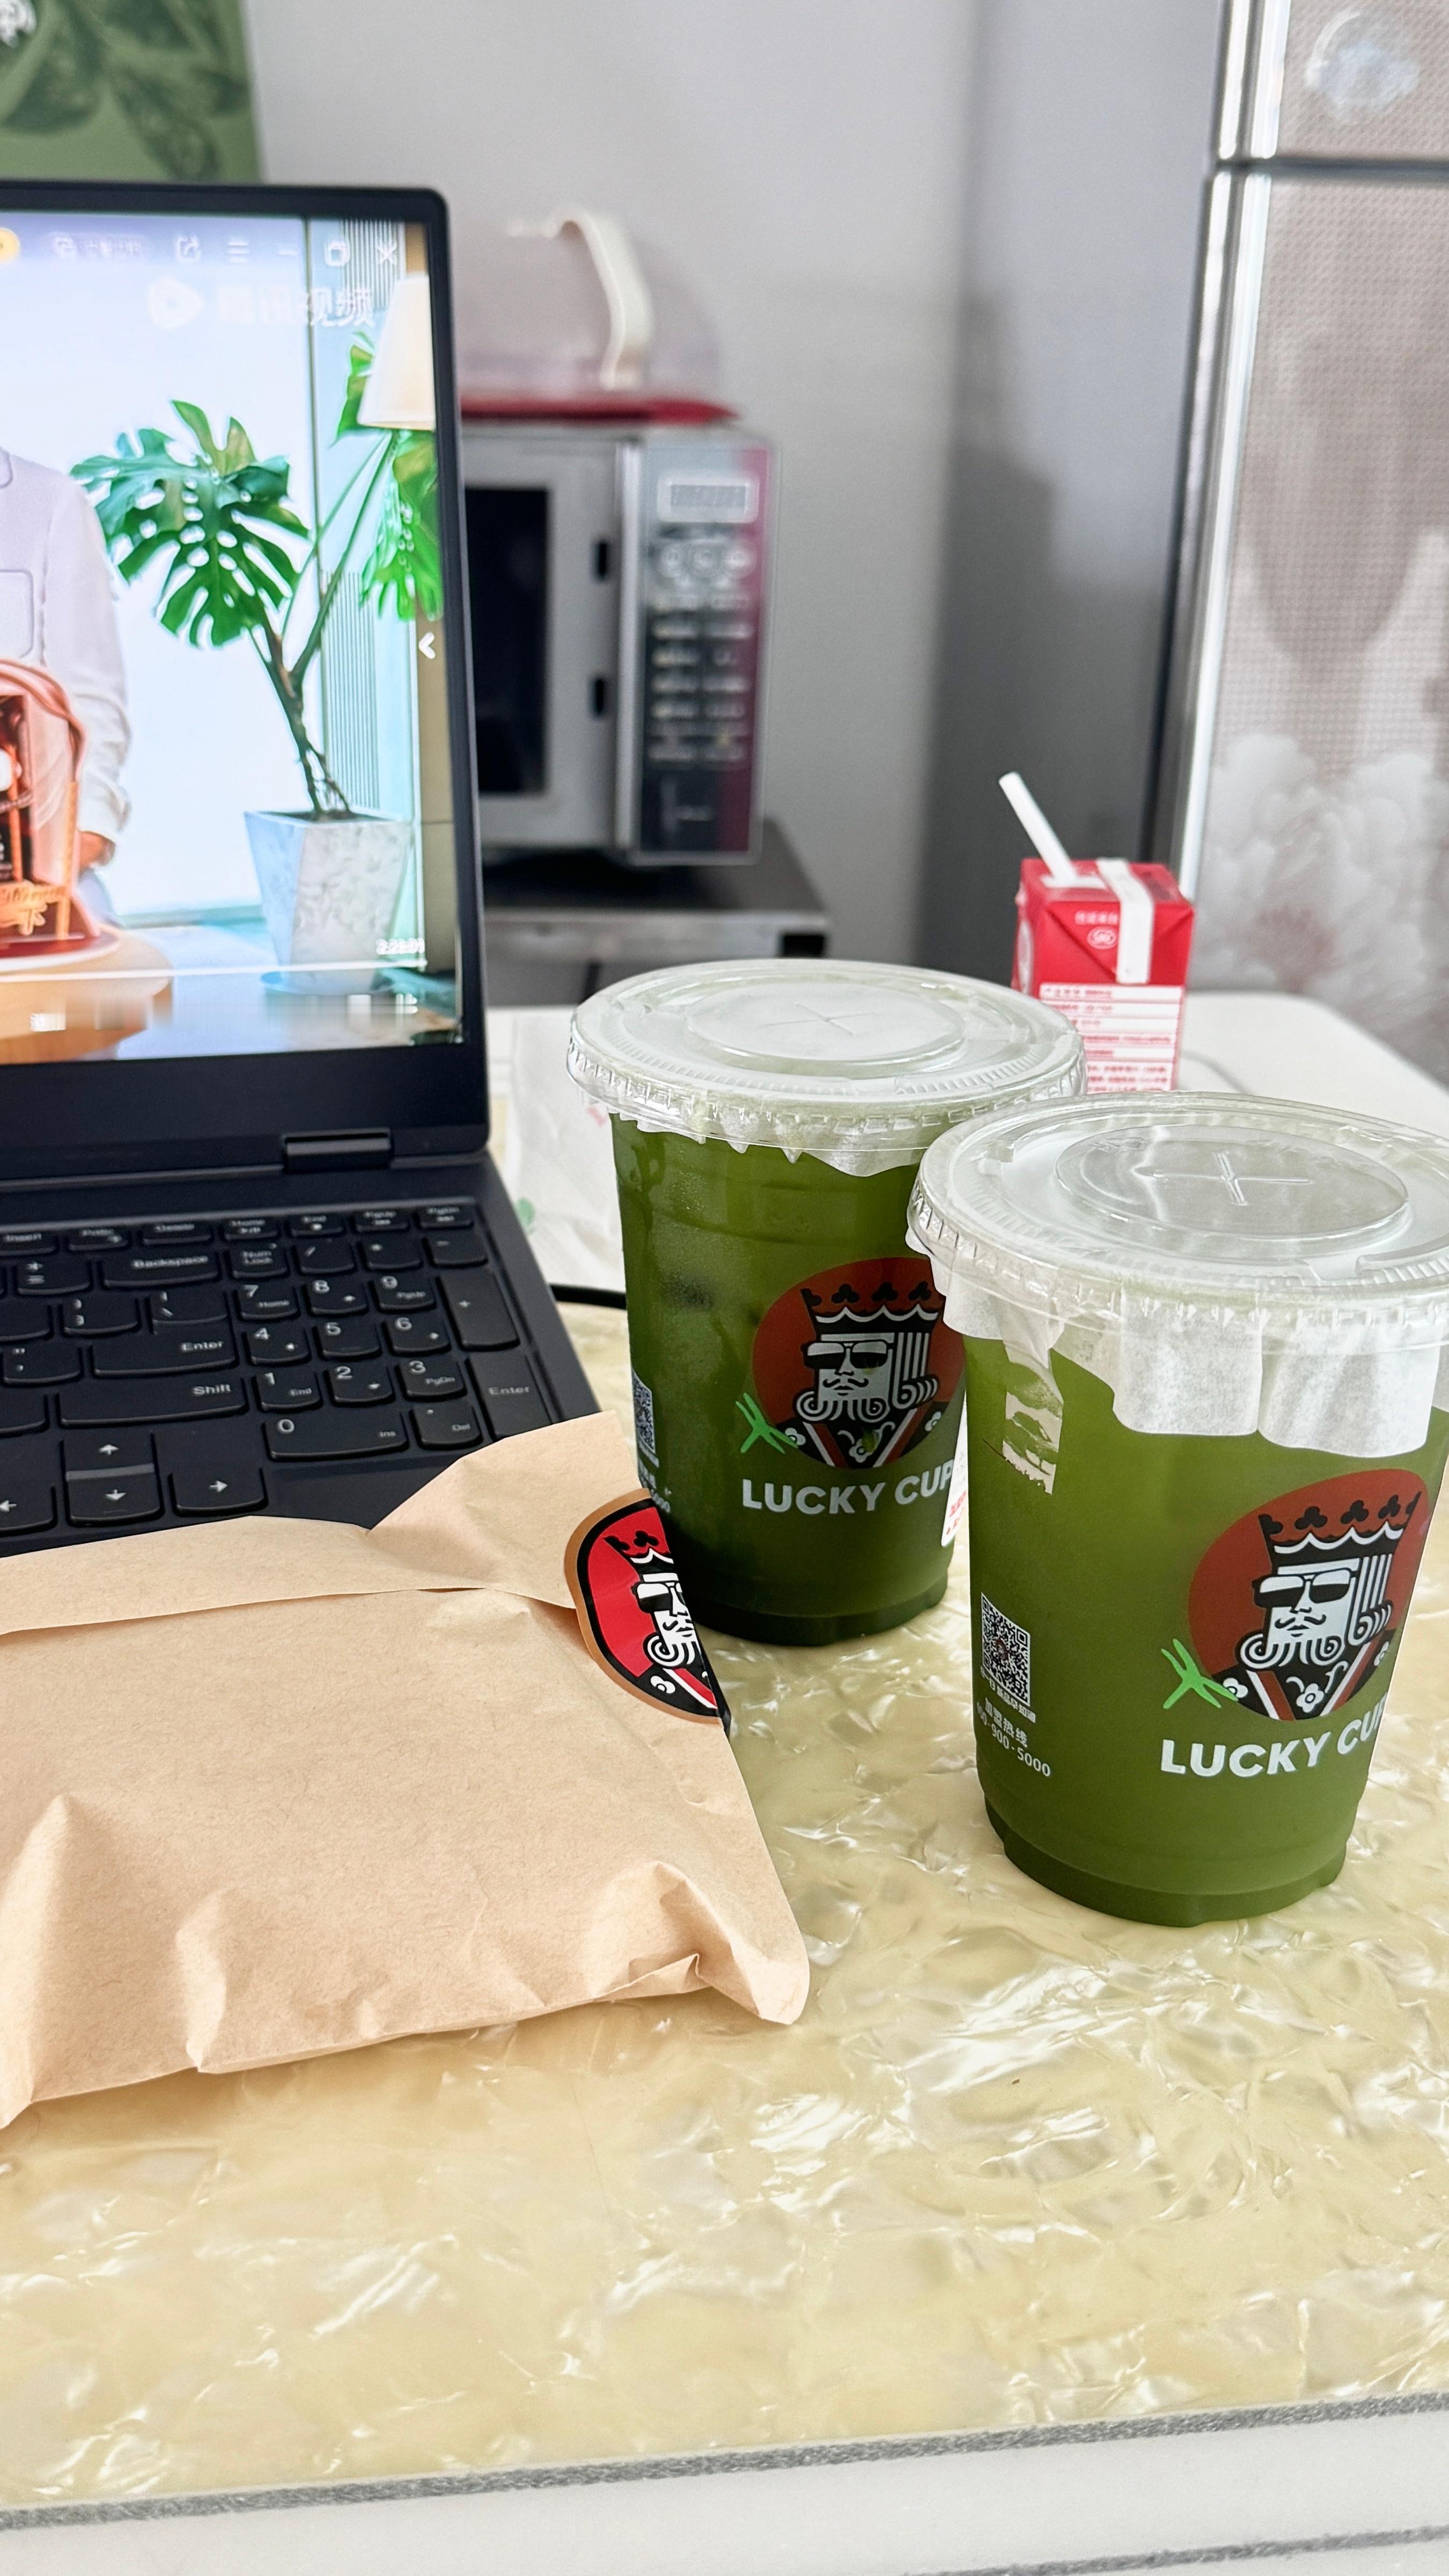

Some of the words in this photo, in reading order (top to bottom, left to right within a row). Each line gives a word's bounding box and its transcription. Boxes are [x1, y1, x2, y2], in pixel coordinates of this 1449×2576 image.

[133, 1256, 208, 1269] Backspace
[314, 1280, 330, 1293] 8
[381, 1276, 398, 1289] 9
[244, 1284, 259, 1298] 7
[326, 1322, 341, 1335] 5
[395, 1318, 412, 1330] 6
[254, 1327, 270, 1341] 4
[180, 1341, 224, 1352] Enter
[335, 1366, 352, 1380] 2
[409, 1360, 426, 1374] 3
[264, 1371, 276, 1386] 1
[425, 1377, 455, 1386] PgDn
[193, 1383, 231, 1395] Shift
[290, 1388, 312, 1396] End
[488, 1385, 530, 1396] Enter
[277, 1419, 295, 1433] 0
[451, 1423, 470, 1431] Del
[742, 1478, 886, 1515] LUCKY
[894, 1459, 954, 1505] CUP
[1160, 1732, 1332, 1777] LUCKY
